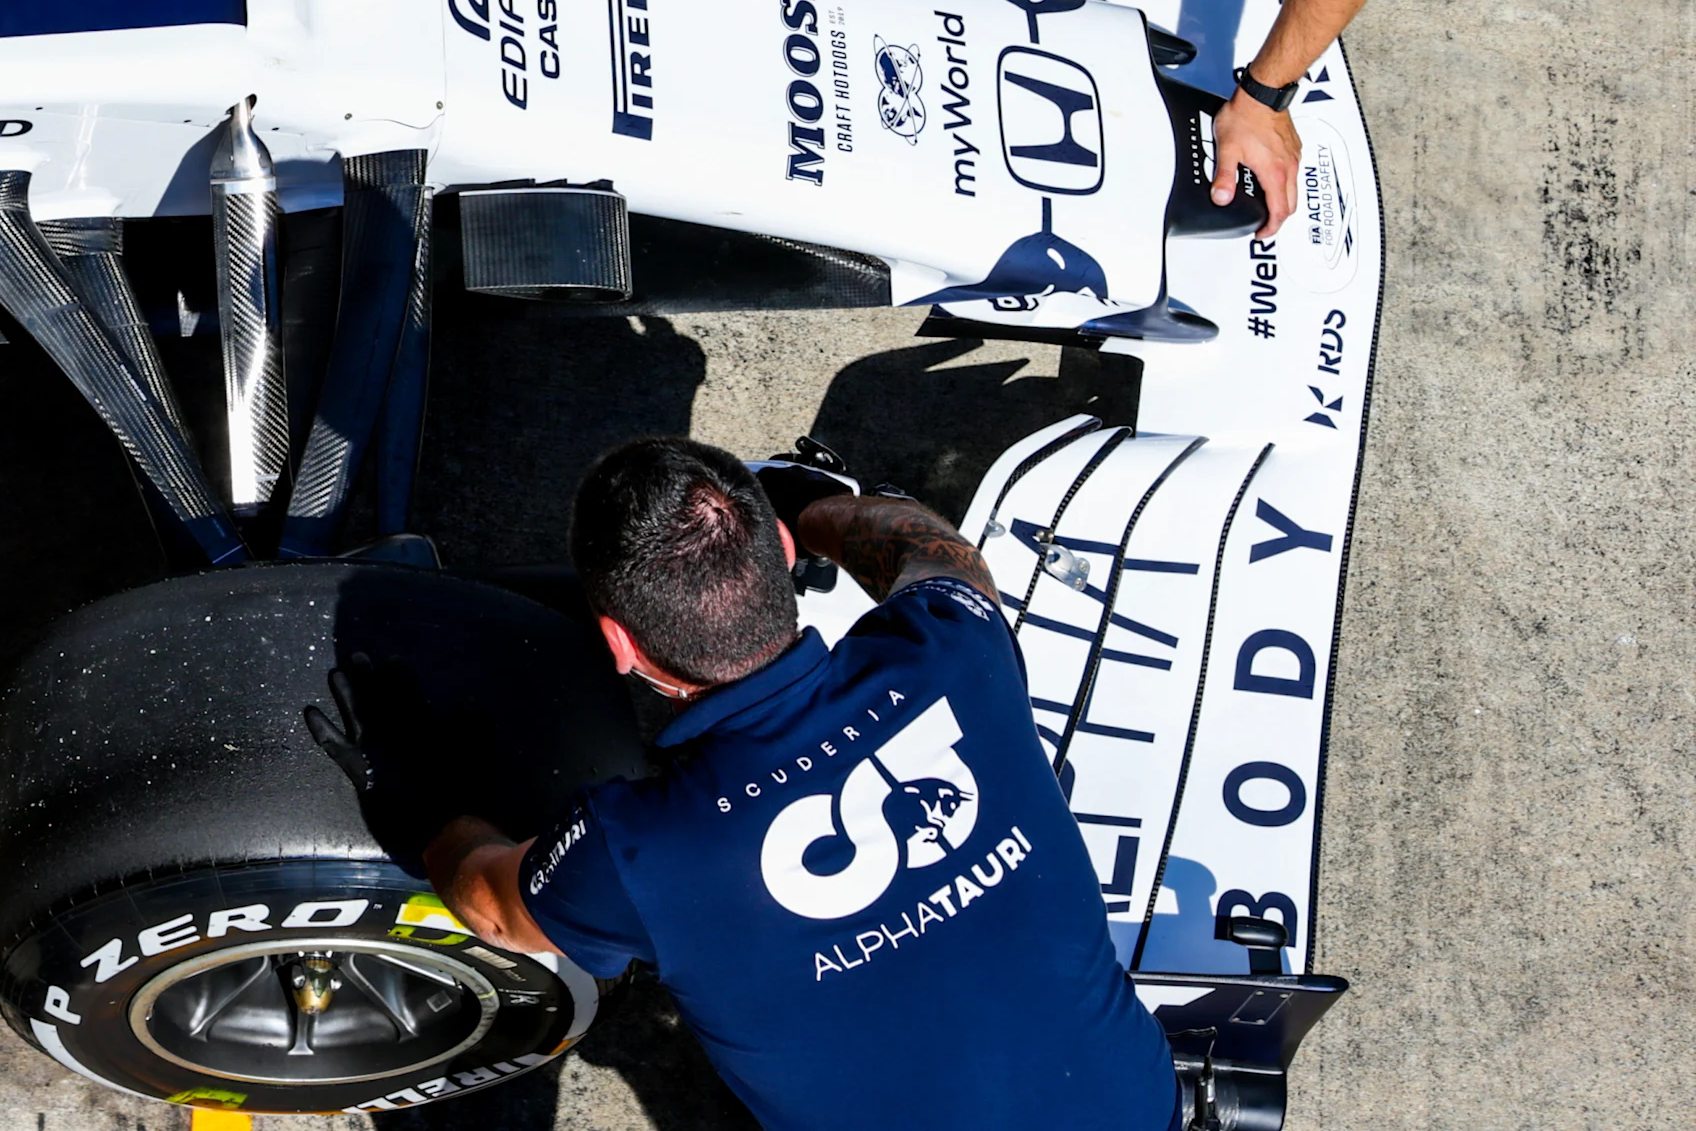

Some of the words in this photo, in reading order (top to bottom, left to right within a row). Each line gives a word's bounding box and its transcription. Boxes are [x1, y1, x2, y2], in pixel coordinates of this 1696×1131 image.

[830, 29, 850, 99] HOTDOGS
[835, 104, 853, 153] CRAFT
[933, 9, 981, 198] myWorld
[1189, 117, 1201, 185] SCUDERIA
[1317, 143, 1333, 188] SAFETY
[1305, 166, 1322, 222] ACTION
[1322, 194, 1335, 227] ROAD
[1324, 231, 1334, 246] FOR
[1317, 309, 1347, 375] RDS
[716, 688, 906, 814] SCUDERIA
[1214, 497, 1334, 948] BODY
[813, 824, 1035, 982] ALPHATAURI
[43, 984, 83, 1026] P
[79, 899, 371, 984] ZERO
